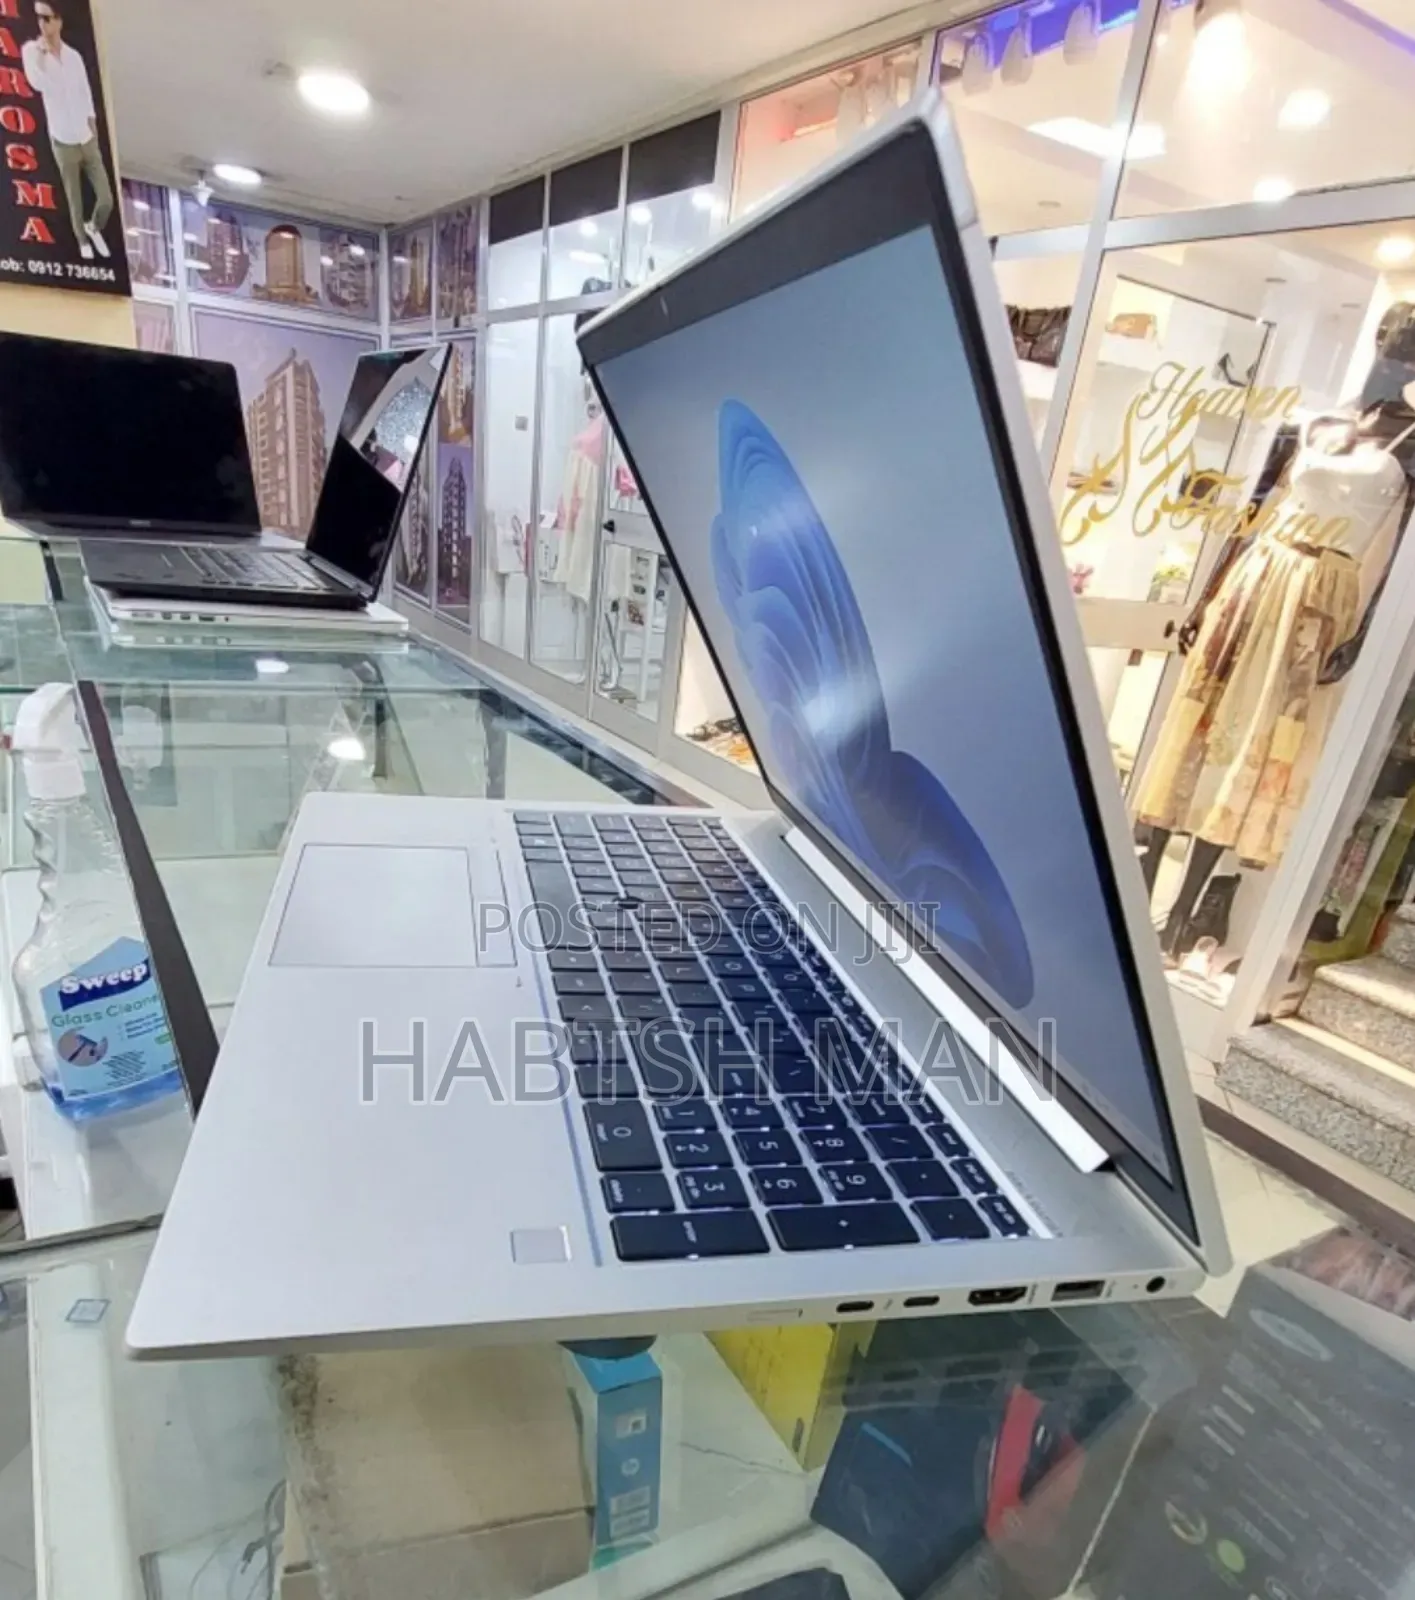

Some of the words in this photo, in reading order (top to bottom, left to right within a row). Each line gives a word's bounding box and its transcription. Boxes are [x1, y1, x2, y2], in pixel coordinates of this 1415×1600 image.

[0, 257, 26, 273] ob:
[28, 260, 63, 277] 0912
[60, 962, 148, 994] Sweep
[51, 1010, 104, 1028] Glass
[612, 1126, 632, 1138] 0
[688, 1143, 710, 1153] 2
[759, 1141, 779, 1150] 5
[825, 1138, 845, 1147] 8
[776, 1178, 798, 1189] 6
[846, 1174, 867, 1185] 9
[704, 1182, 726, 1192] 3
